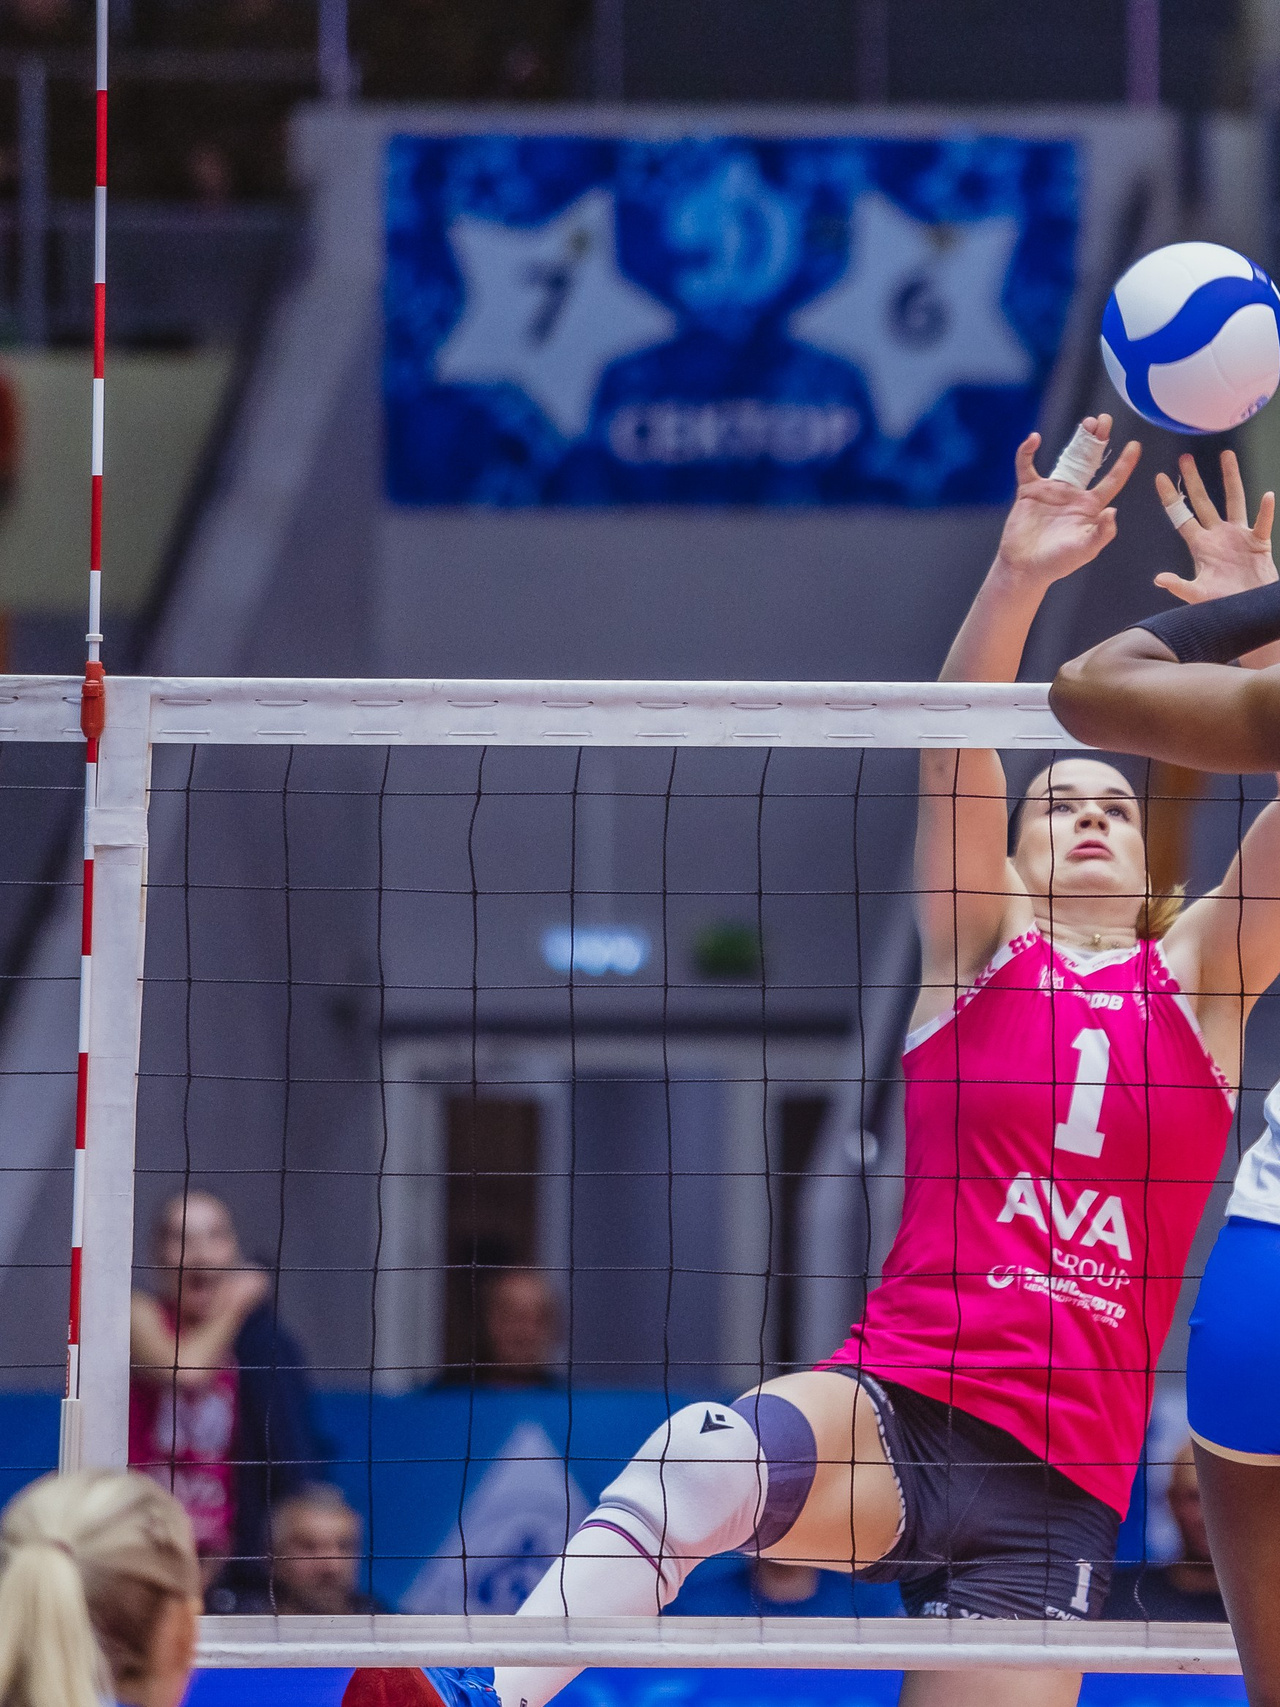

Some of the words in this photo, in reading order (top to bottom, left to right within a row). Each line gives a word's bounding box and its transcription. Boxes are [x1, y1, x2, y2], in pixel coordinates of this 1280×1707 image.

[524, 258, 576, 348] 7
[886, 277, 951, 353] 6
[1082, 992, 1124, 1010] ФВ
[1054, 1028, 1110, 1158] 1
[996, 1171, 1132, 1261] AVA
[1070, 1558, 1094, 1614] 1
